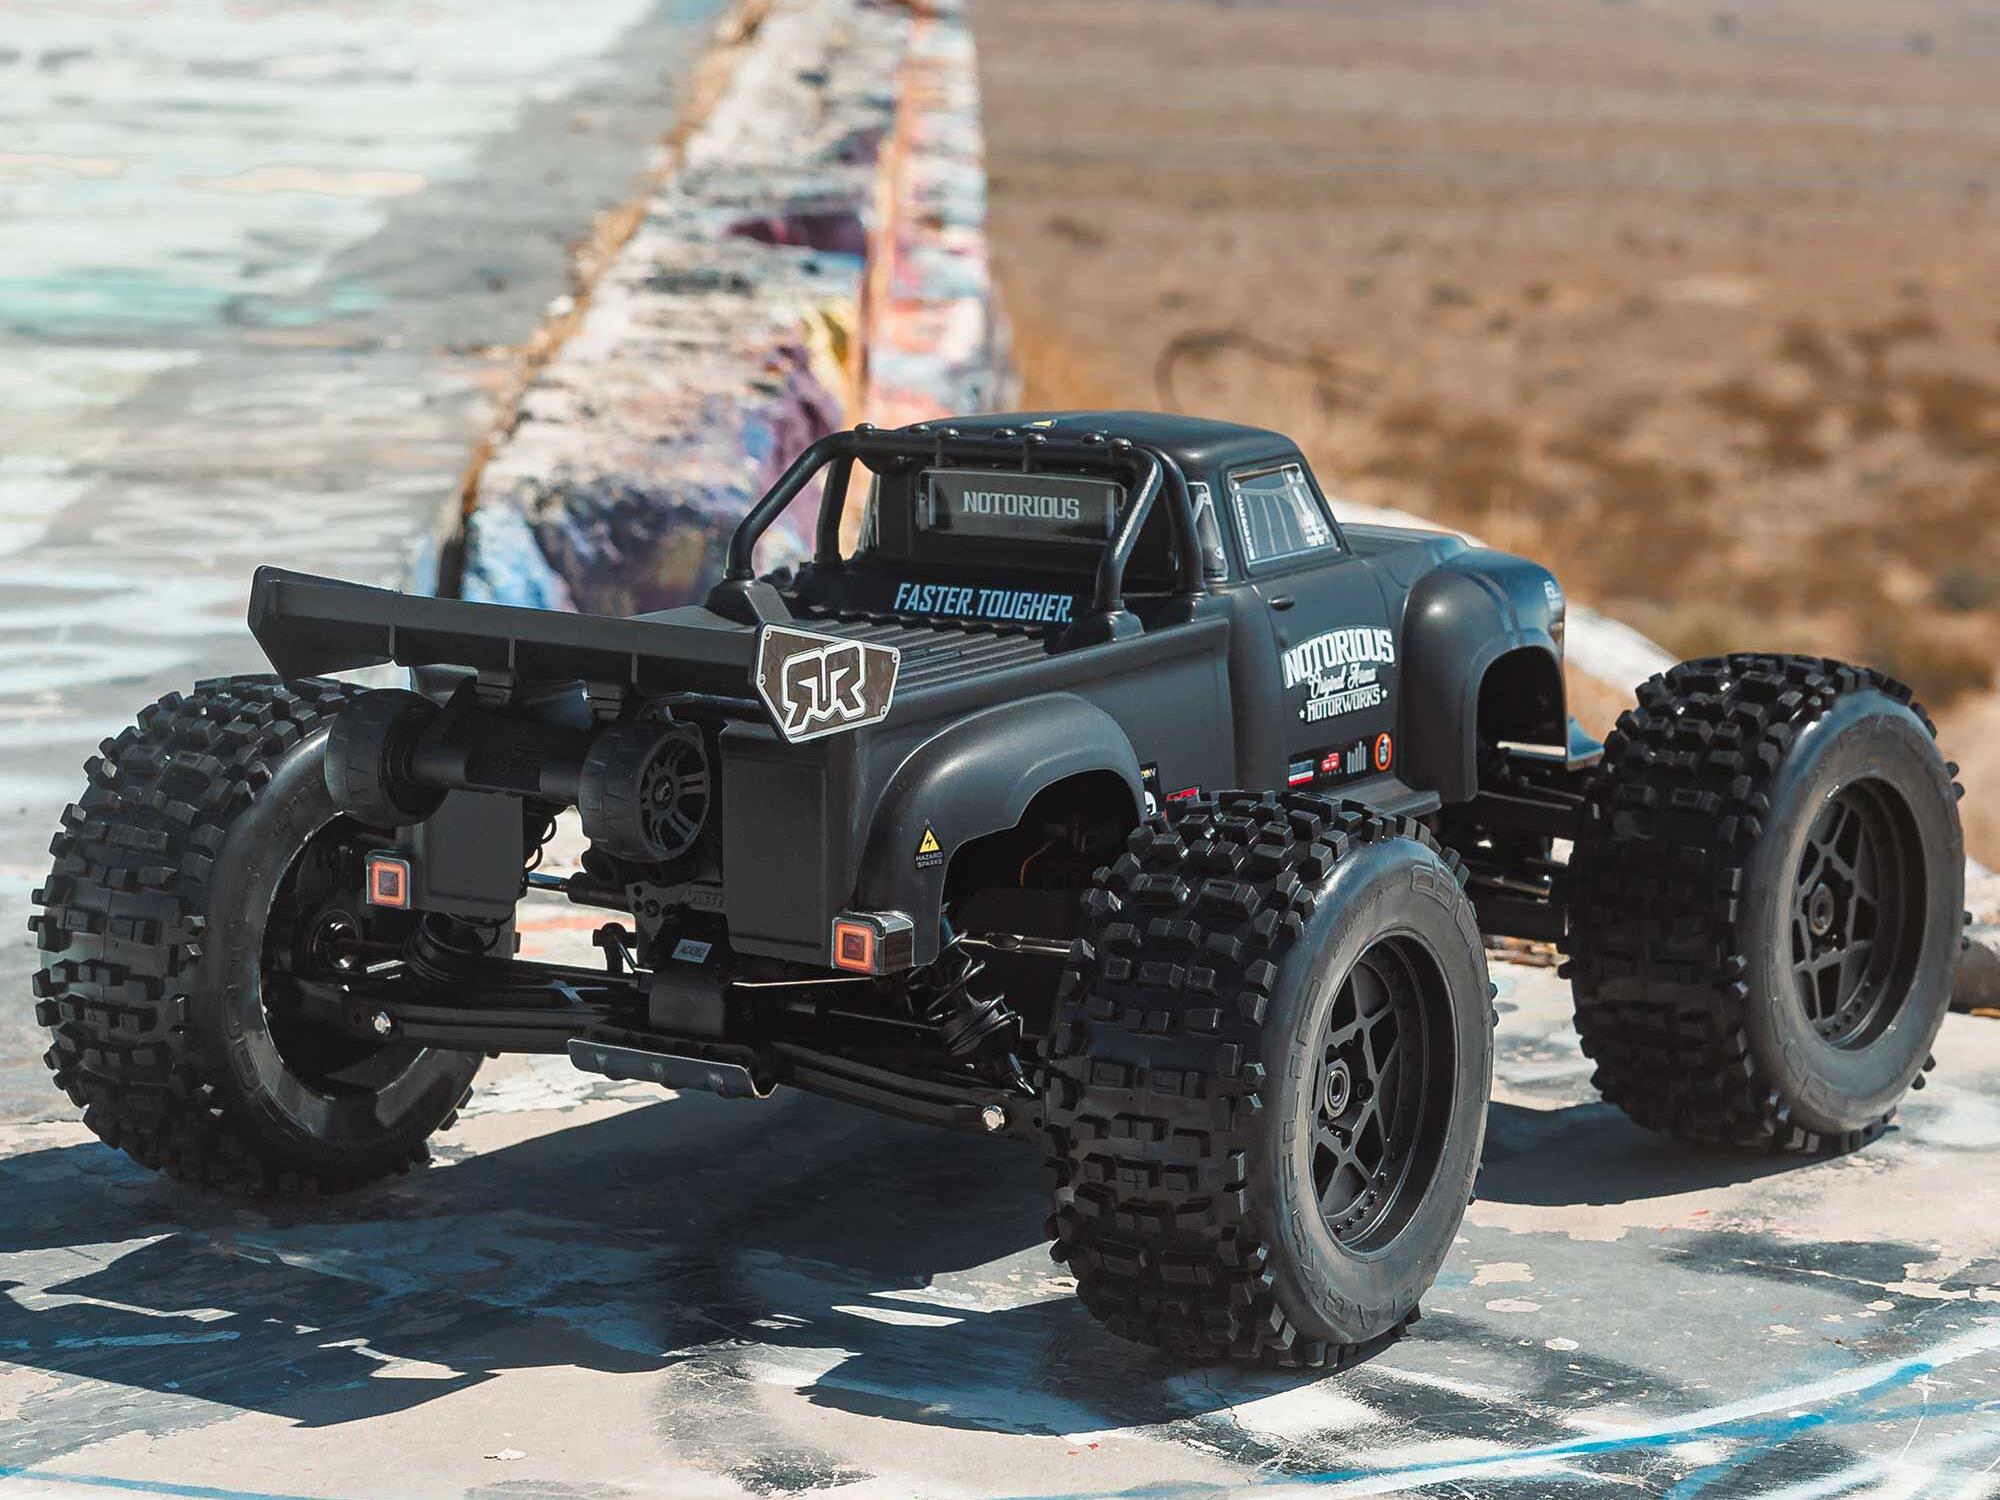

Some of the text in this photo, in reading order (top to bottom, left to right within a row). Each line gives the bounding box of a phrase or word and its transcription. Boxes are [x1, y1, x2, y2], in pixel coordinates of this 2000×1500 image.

[962, 490, 1080, 521] NOTORIOUS
[1284, 628, 1395, 689] NOTORIOUS
[1306, 687, 1380, 722] MOTORWORKS
[915, 851, 943, 861] HAZARD
[916, 859, 943, 869] SPARKS
